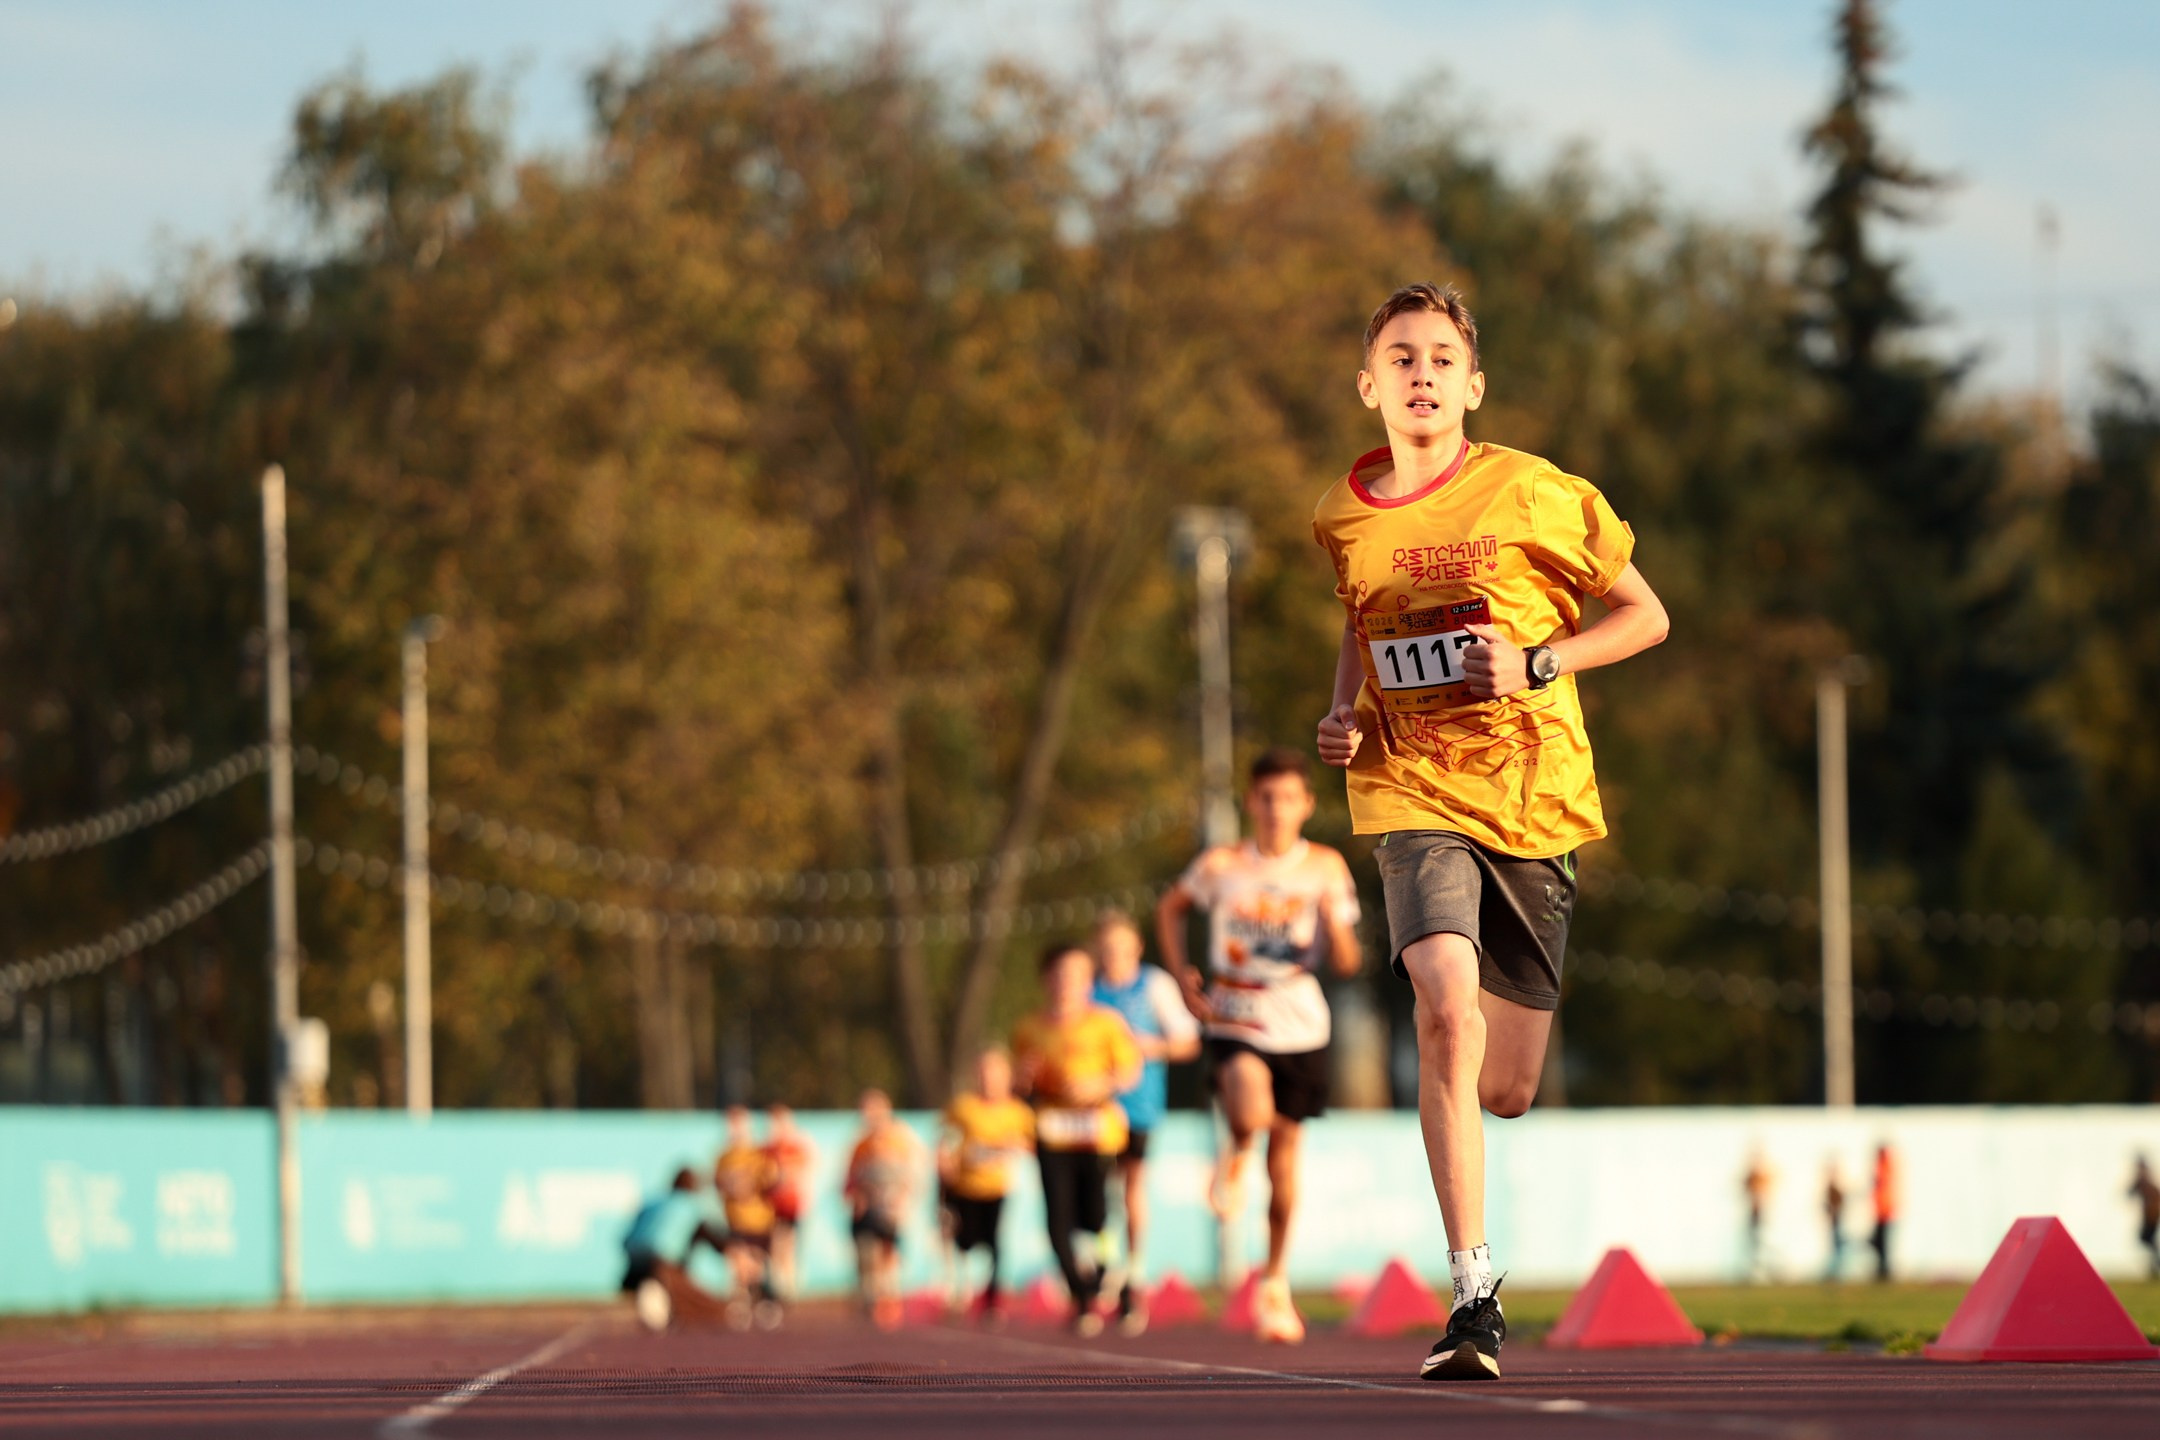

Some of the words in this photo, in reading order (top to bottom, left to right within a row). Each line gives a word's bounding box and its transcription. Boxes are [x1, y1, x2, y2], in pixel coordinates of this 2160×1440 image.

[1392, 535, 1497, 573] ДЕТСКИЙ
[1452, 604, 1469, 613] 12-13
[1514, 757, 1545, 767] 202
